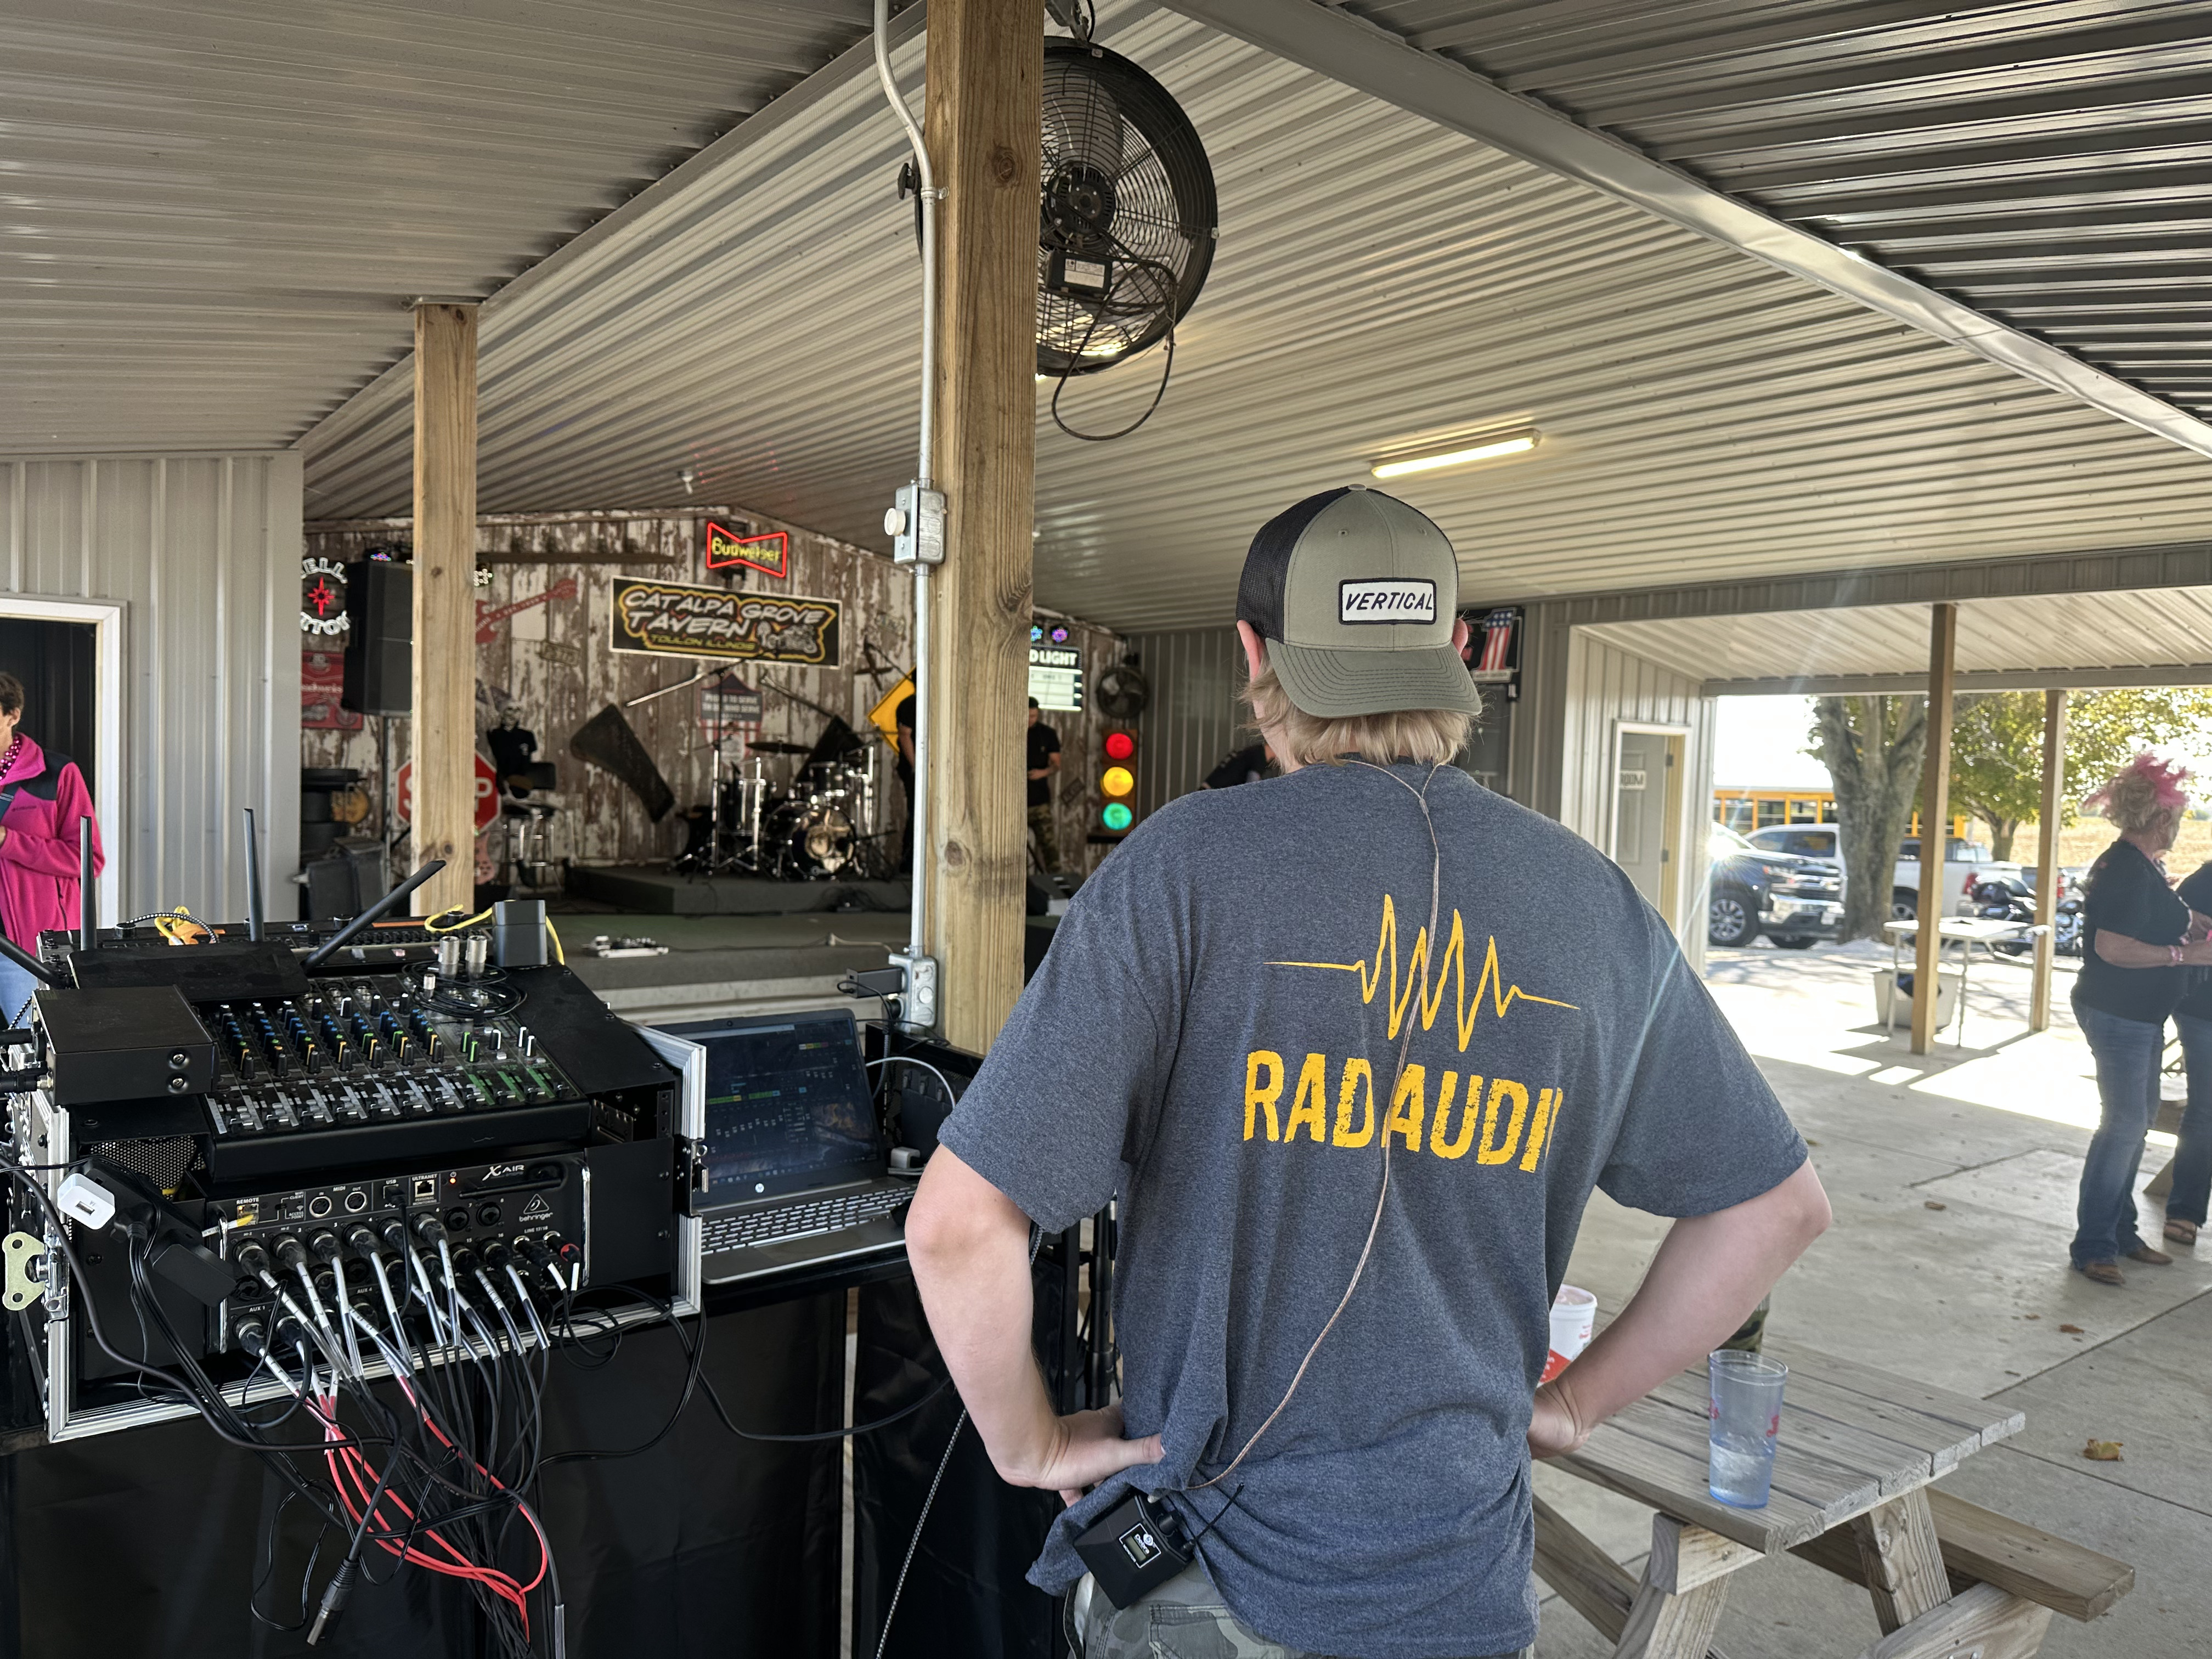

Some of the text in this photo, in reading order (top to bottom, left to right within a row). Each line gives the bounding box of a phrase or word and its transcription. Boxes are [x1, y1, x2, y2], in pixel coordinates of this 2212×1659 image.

[712, 537, 781, 565] Budweiser
[1346, 592, 1432, 611] VERTICAL
[741, 603, 826, 624] GROVE
[629, 611, 751, 638] TAVERN
[1243, 1050, 1564, 1173] RAD AUDI
[412, 1173, 438, 1181] ULTRANET
[519, 1212, 554, 1222] behringer
